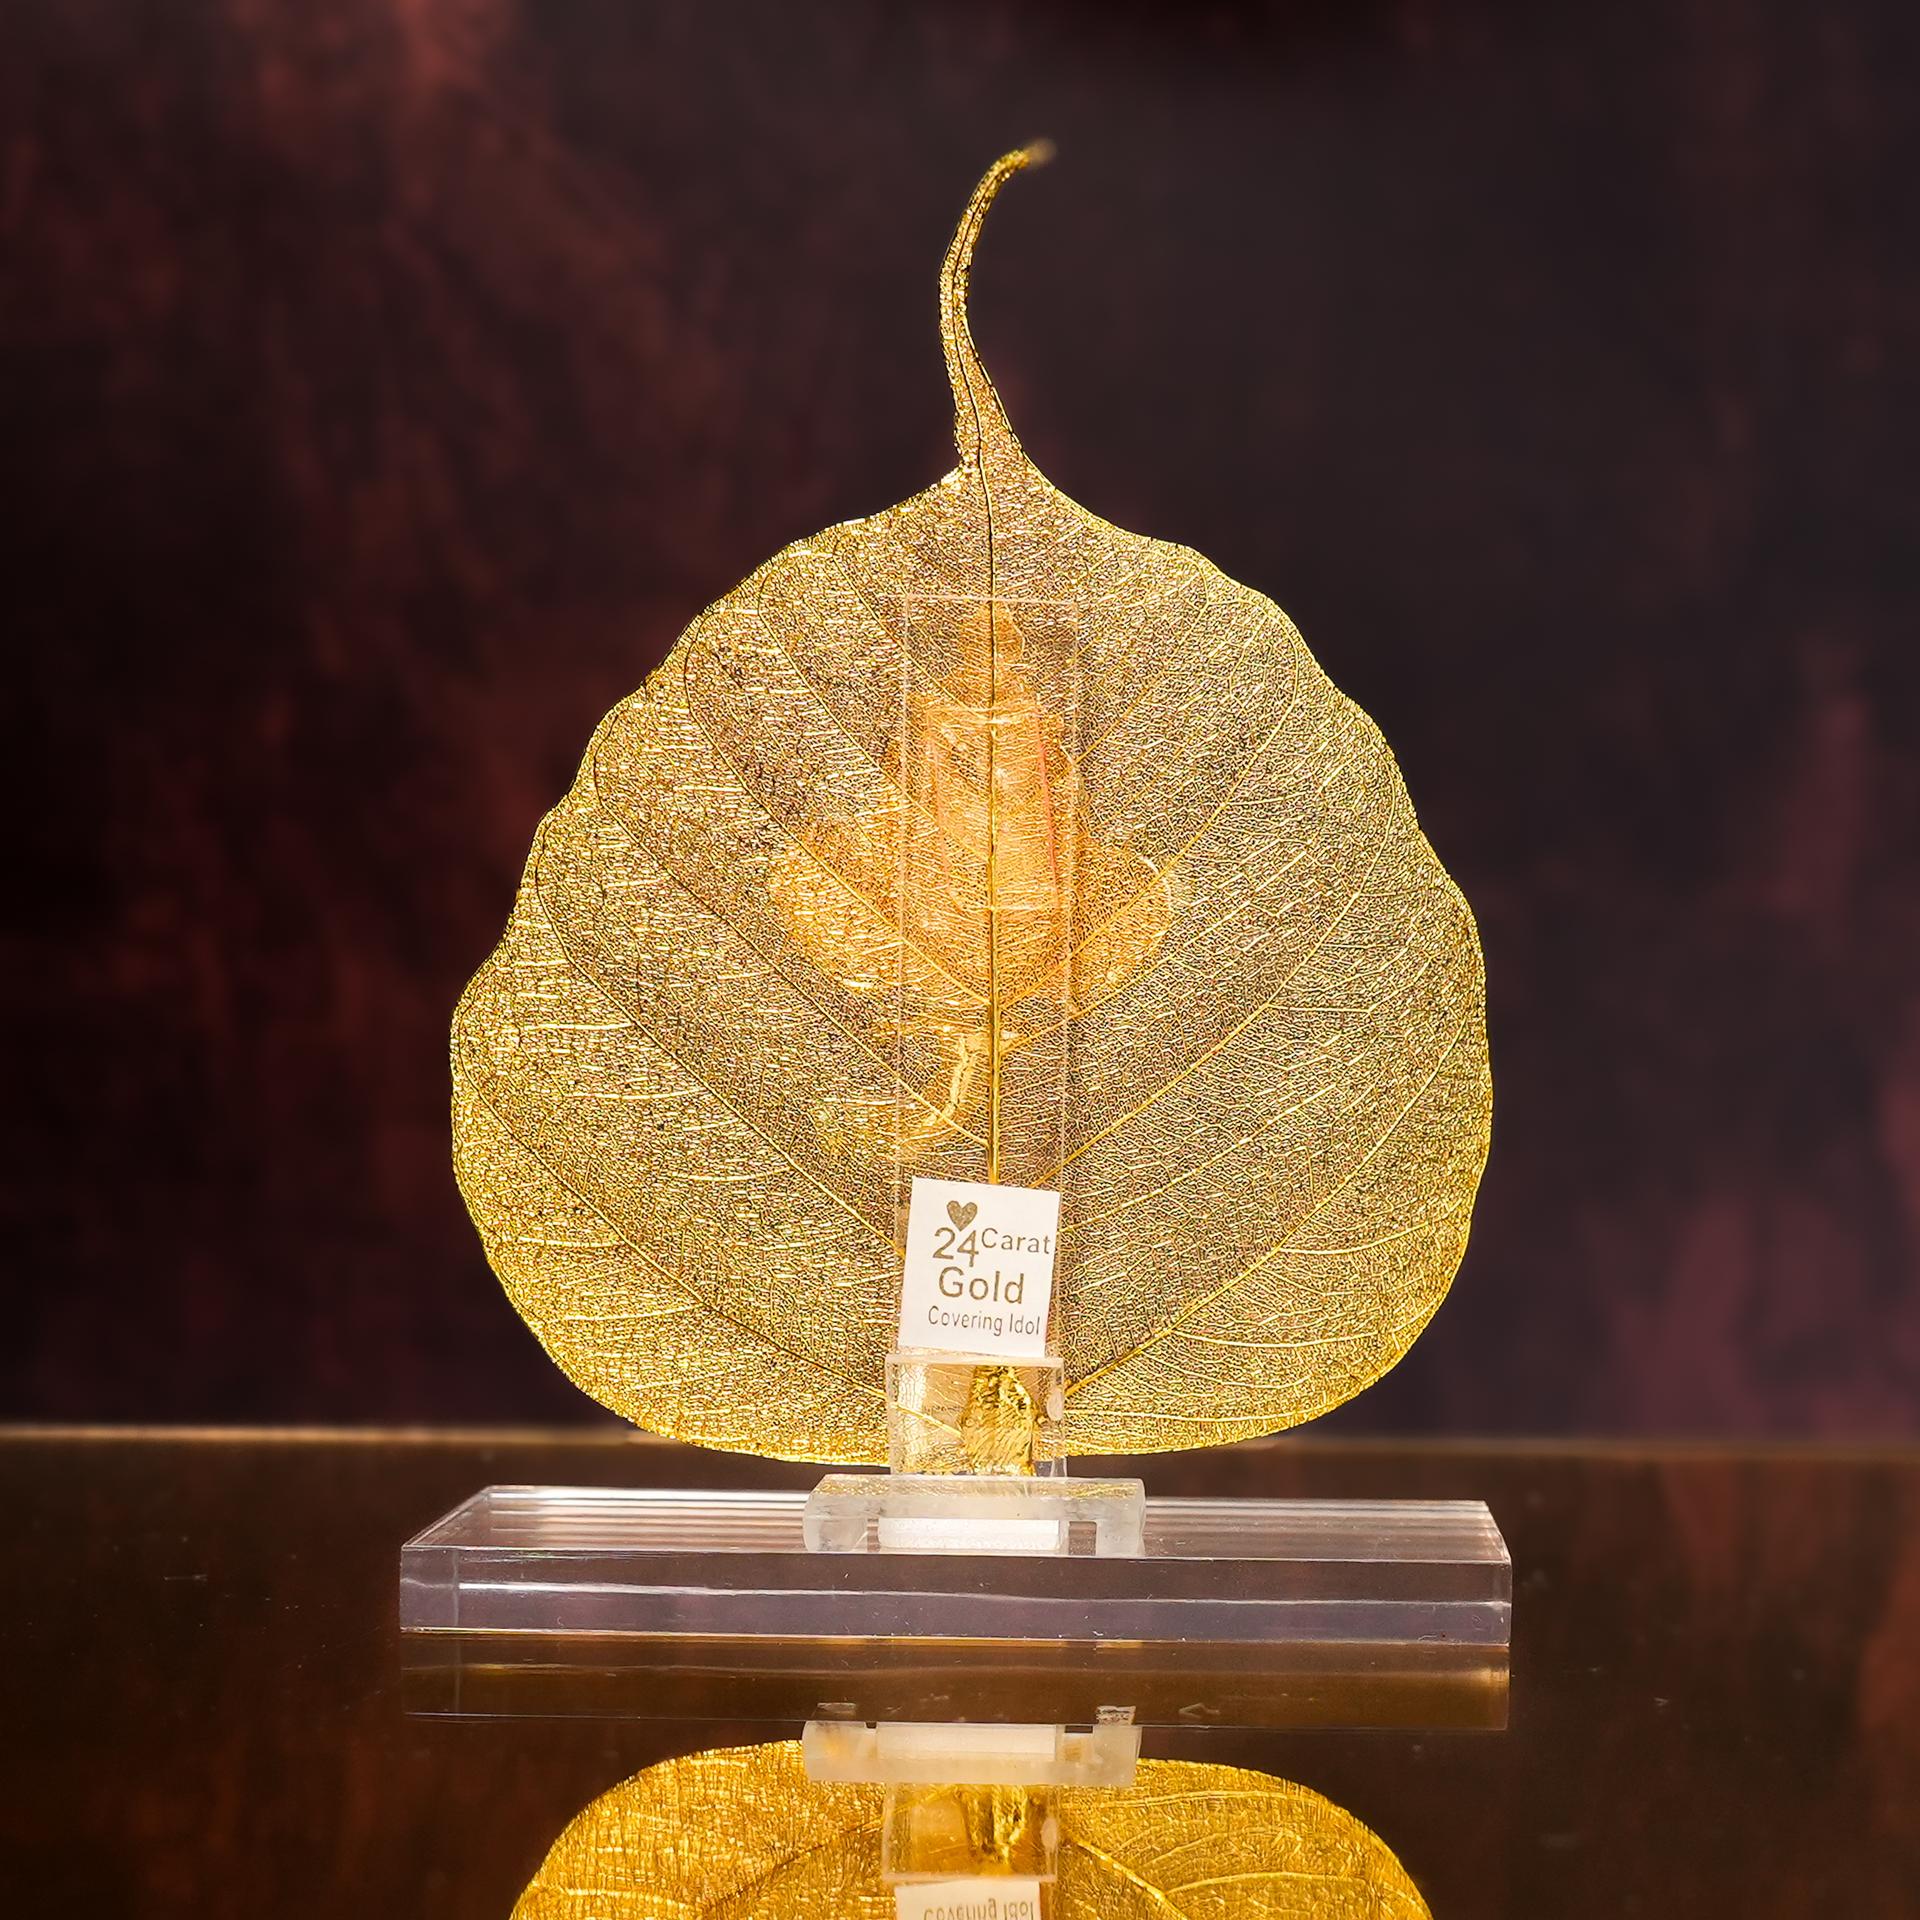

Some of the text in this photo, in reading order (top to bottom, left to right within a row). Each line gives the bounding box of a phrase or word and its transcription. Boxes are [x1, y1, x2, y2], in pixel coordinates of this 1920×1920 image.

[932, 1227, 1051, 1268] 24 Carat
[938, 1266, 1025, 1305] Gold
[928, 1305, 1041, 1337] Covering Idol
